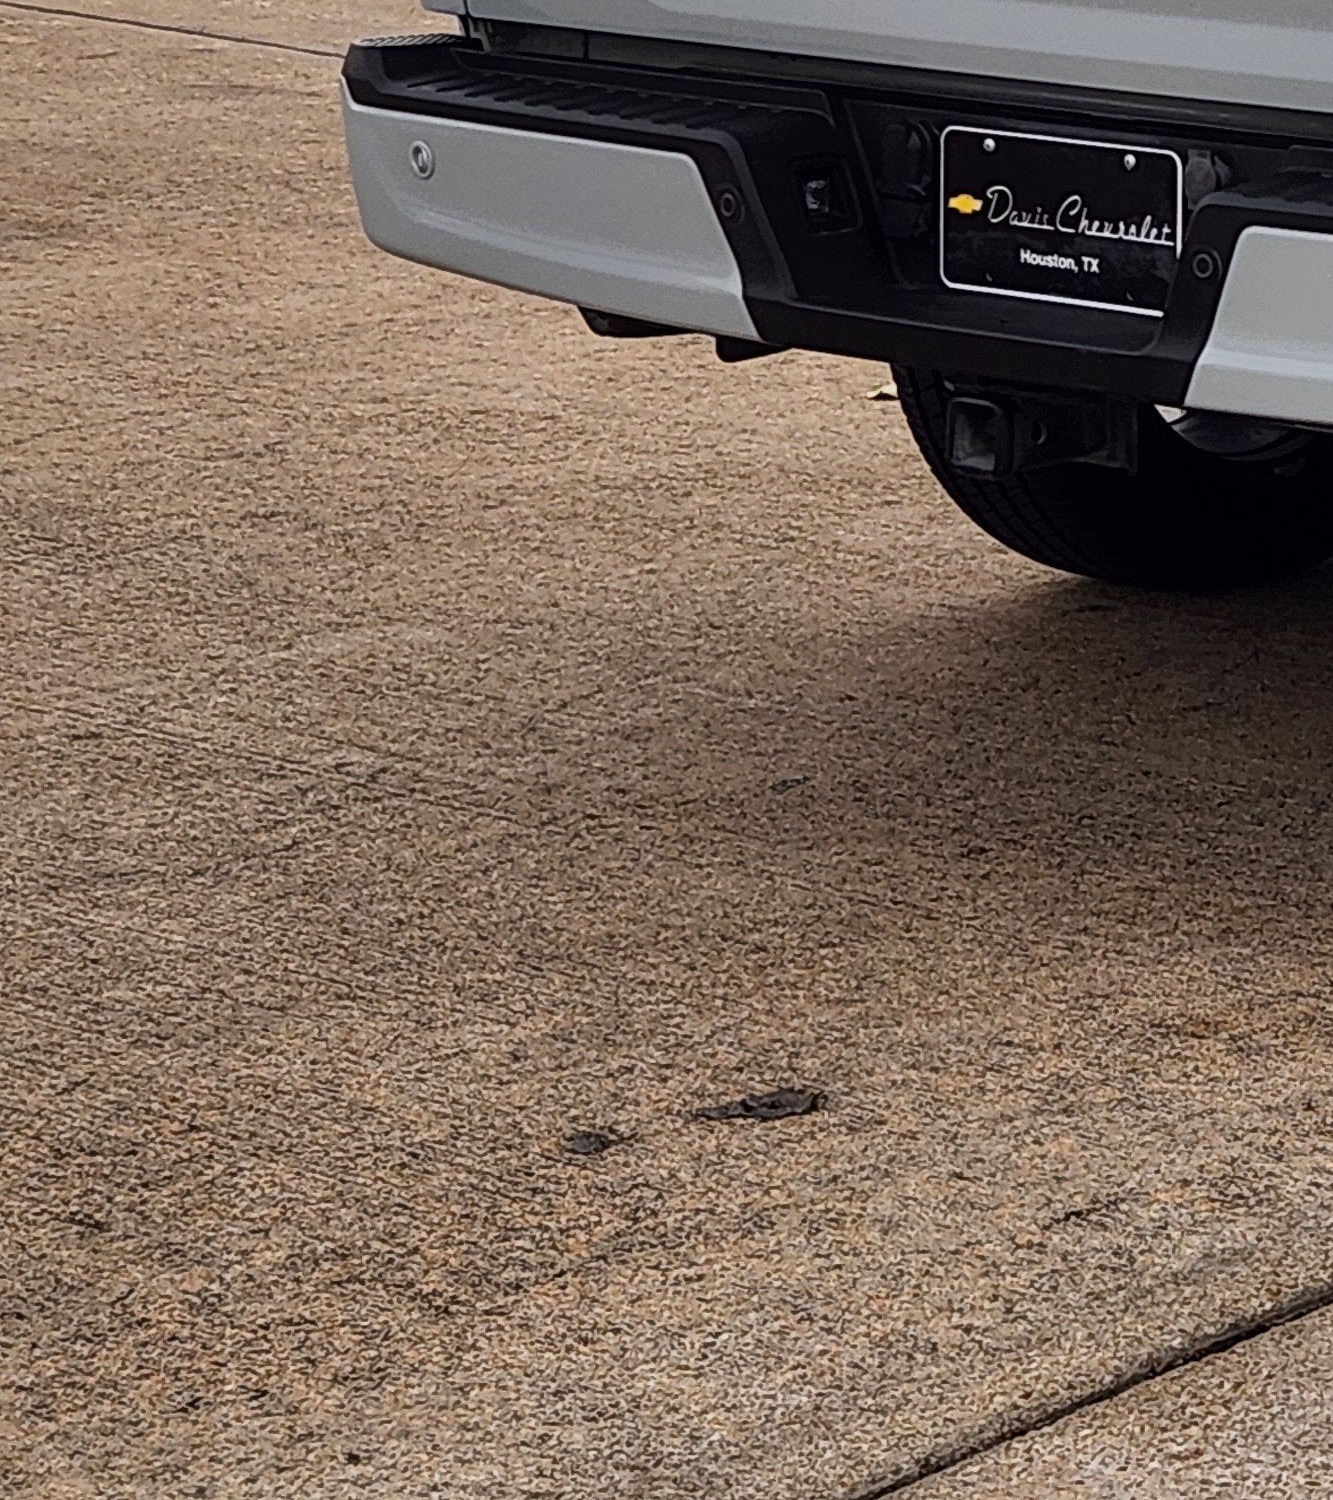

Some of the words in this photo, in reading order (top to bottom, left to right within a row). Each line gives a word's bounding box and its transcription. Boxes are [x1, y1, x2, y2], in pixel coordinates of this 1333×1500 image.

[986, 185, 1055, 231] Davis
[1056, 194, 1175, 247] Chevrolet
[1019, 248, 1079, 273] Houston,
[1081, 255, 1101, 273] TX
